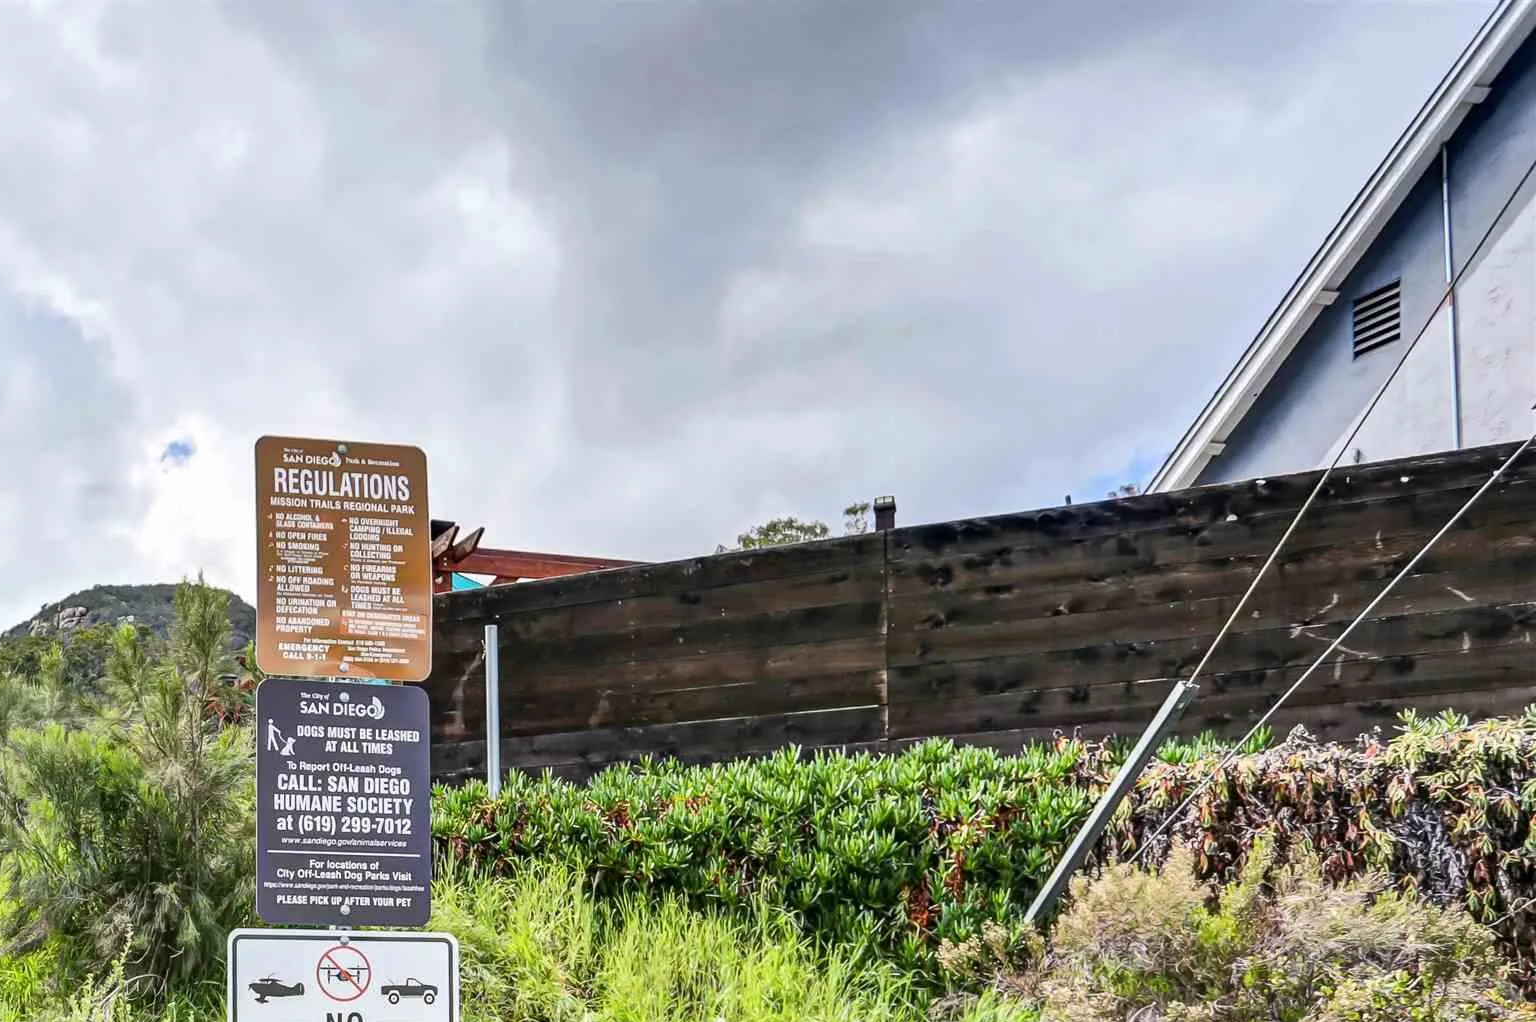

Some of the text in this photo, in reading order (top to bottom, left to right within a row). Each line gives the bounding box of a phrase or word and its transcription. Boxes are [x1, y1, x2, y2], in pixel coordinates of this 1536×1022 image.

[283, 453, 303, 463] SAN
[306, 455, 339, 466] DIEGO
[274, 467, 410, 501] REGULATIONS
[270, 497, 414, 514] MISSION TRAILS REGIONAL PARK
[350, 524, 381, 534] CAMPING
[276, 531, 286, 539] NO
[288, 532, 306, 540] OPEN
[350, 533, 380, 541] LODGING
[288, 542, 320, 551] SMOKING
[361, 543, 392, 552] HUNTING
[350, 550, 392, 560] COLLECTING
[276, 564, 324, 574] NO LITTERING
[350, 564, 360, 572] NO
[302, 576, 334, 586] ROADING
[276, 584, 310, 592] ALLOWED
[276, 598, 286, 606] NO
[276, 606, 318, 614] DEFECATION
[276, 616, 286, 624] NO
[278, 642, 330, 652] EMERGENCY
[282, 652, 304, 660] CALL
[312, 692, 324, 700] City
[300, 701, 378, 718] SAN DIEGO
[297, 725, 420, 742] DOGS MUST BE LEASHED
[325, 741, 393, 755] AT ALL TIMES
[286, 760, 402, 776] To Report Off-Leash Dogs
[278, 774, 410, 796] CALL: SAN DIEGO
[274, 794, 414, 815] HUMANE SOCIETY
[276, 814, 412, 836] at (619) 299-7012
[310, 859, 380, 870] For locations of
[276, 868, 412, 882] City Off-Leash Dog Parks Visit
[276, 895, 412, 908] PLEASE PICK UP AFTER YOUR PET
